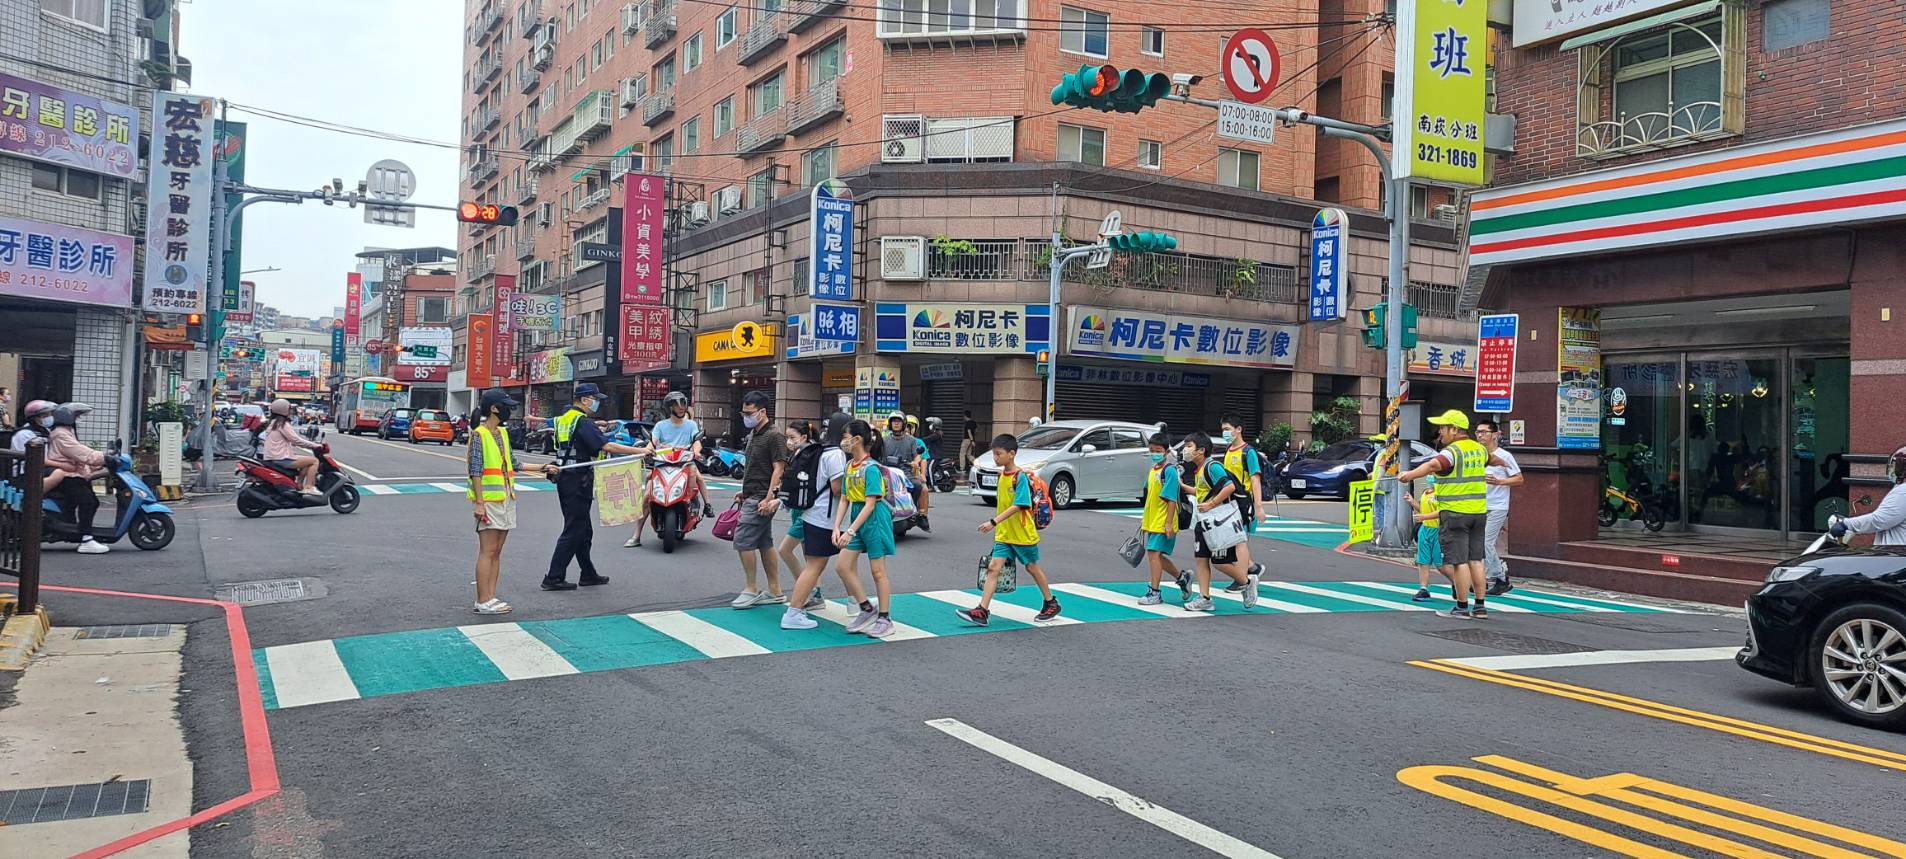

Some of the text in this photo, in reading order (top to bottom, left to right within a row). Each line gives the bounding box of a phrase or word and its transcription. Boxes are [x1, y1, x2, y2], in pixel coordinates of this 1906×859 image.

[3, 86, 129, 145] 牙醫診所
[1222, 104, 1273, 125] 07:00-08:00
[1221, 120, 1271, 139] 15:00-16:00
[1418, 114, 1478, 141] 南崁分班
[34, 130, 129, 164] 212-6022
[1418, 143, 1477, 169] 321-1869
[482, 206, 495, 219] 28
[817, 199, 851, 212] Konica
[636, 204, 652, 279] 小資美學
[822, 213, 844, 272] 柯尼卡
[1313, 228, 1339, 239] Konica
[0, 229, 115, 278] 牙醫診所
[1317, 240, 1333, 296] 柯尼卡
[20, 274, 88, 293] 212-6022
[152, 287, 198, 299] 預約專線
[152, 298, 197, 309] 212-6022
[629, 310, 643, 339] 美甲
[817, 311, 857, 338] 照相
[955, 310, 1019, 330] 柯尼卡
[913, 330, 951, 341] Konica
[955, 332, 1019, 348] 數位影像
[1079, 331, 1104, 340] Konica
[1108, 317, 1290, 358] 柯尼卡數位影像
[1353, 486, 1373, 525] 停
